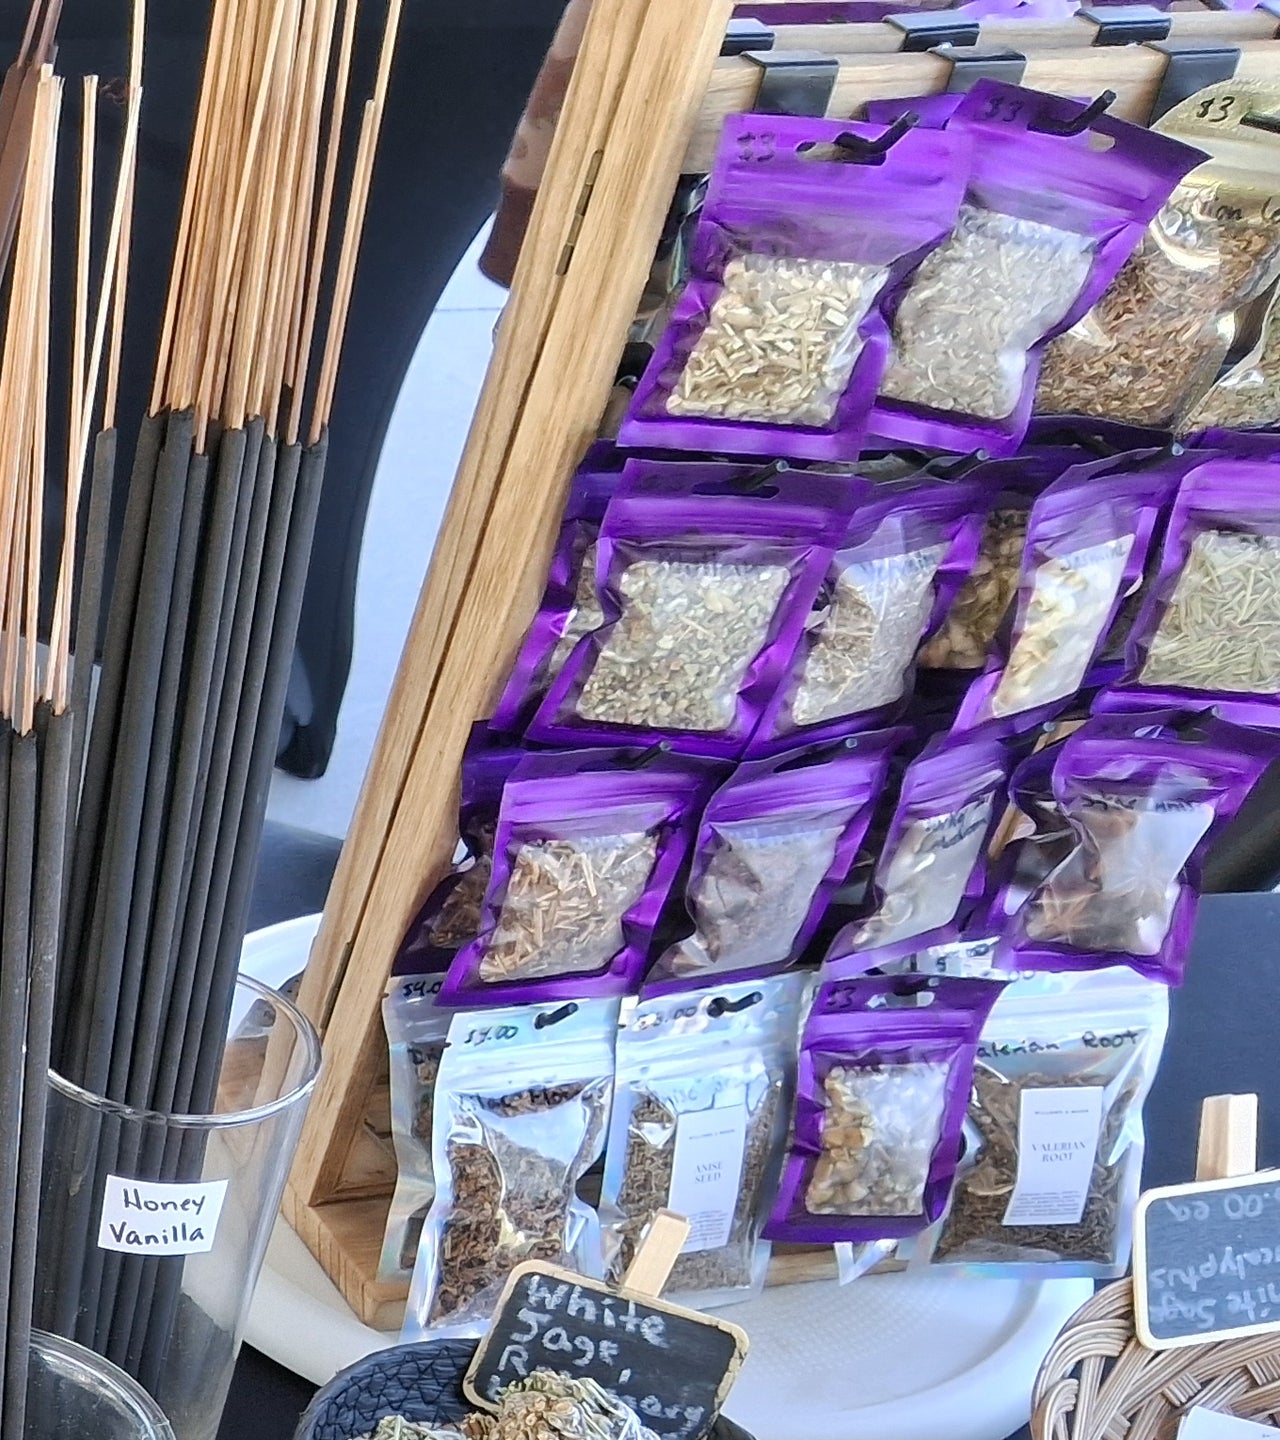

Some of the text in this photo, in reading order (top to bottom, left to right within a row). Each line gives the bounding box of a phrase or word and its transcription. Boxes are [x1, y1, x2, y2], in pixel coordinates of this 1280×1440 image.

[1081, 1029, 1139, 1049] Root
[1031, 1141, 1087, 1152] VALERIAN
[1042, 1152, 1073, 1163] ROOT
[123, 1187, 206, 1215] Honey
[108, 1221, 205, 1246] Vanilla
[527, 1274, 671, 1349] White
